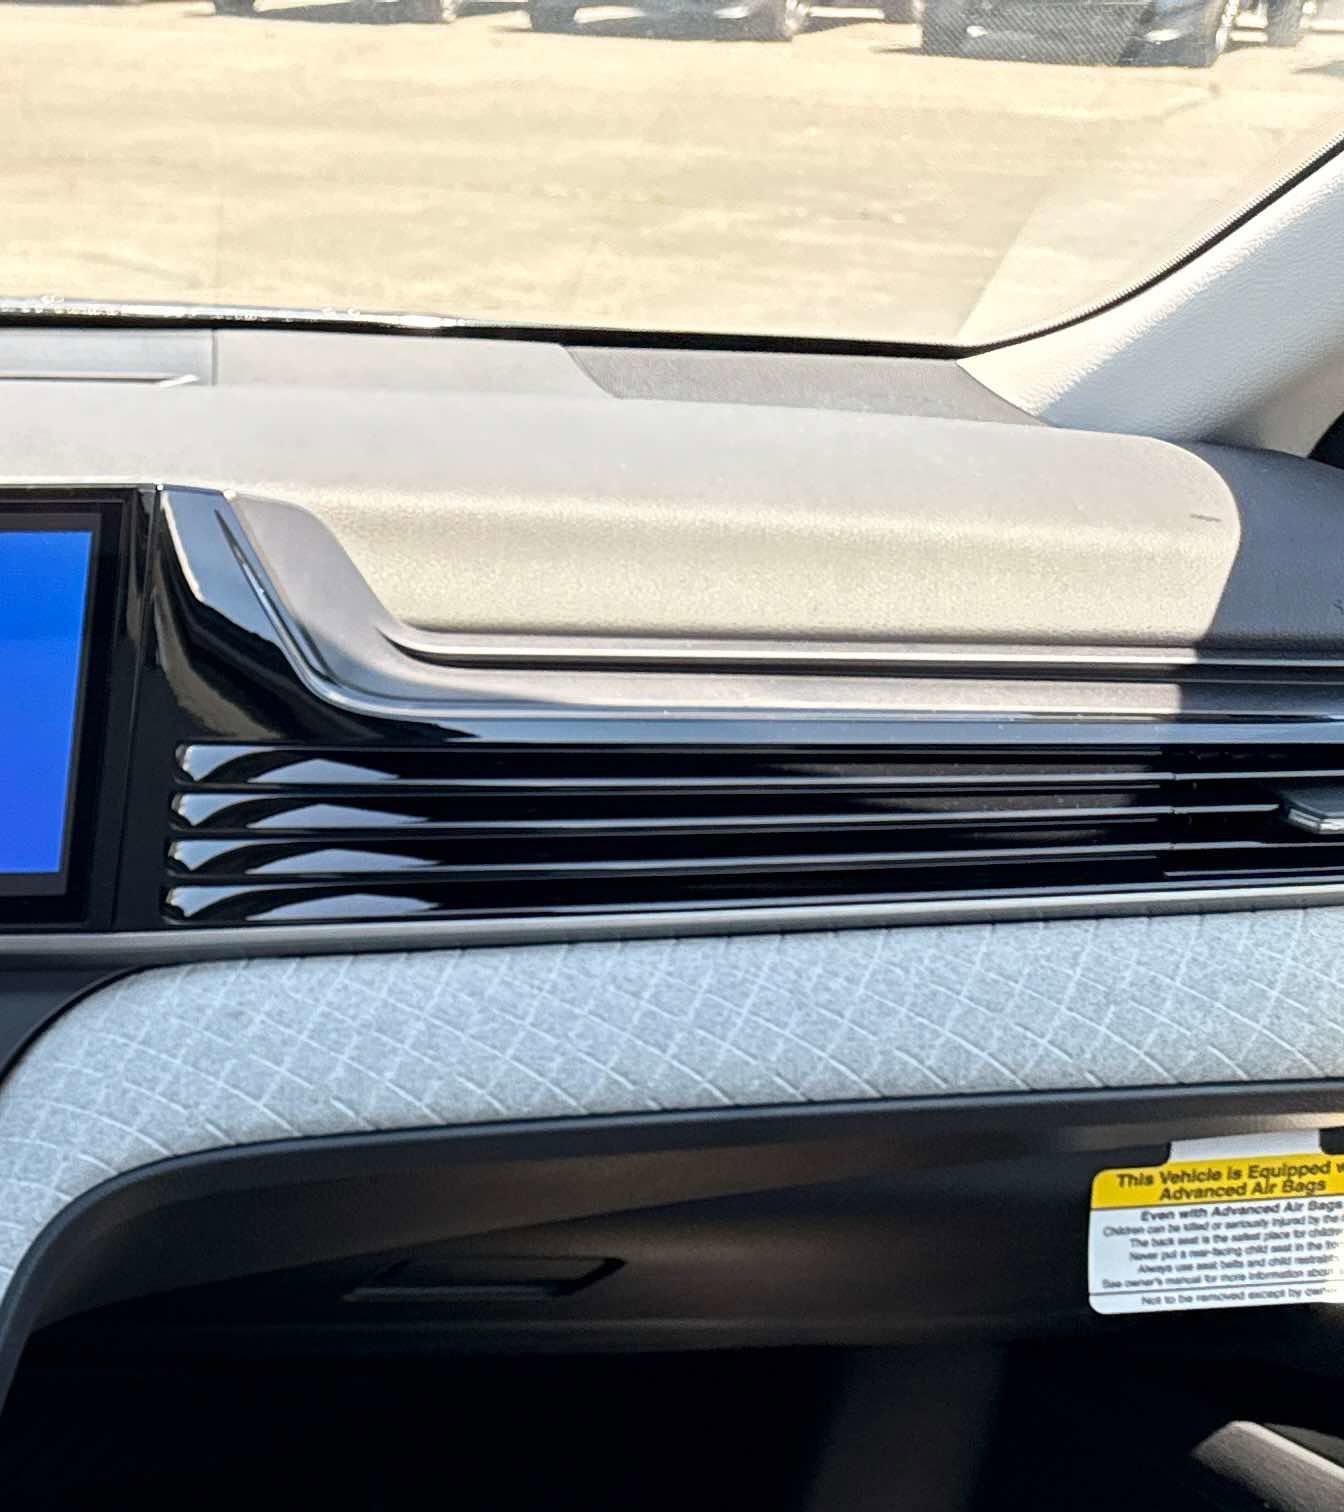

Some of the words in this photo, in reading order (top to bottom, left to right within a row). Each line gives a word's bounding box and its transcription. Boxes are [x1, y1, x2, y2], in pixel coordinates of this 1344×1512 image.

[1117, 1173, 1154, 1188] This
[1159, 1167, 1221, 1184] Vehicle
[1247, 1160, 1331, 1182] Equipped
[1160, 1182, 1247, 1201] Advanced
[1251, 1181, 1277, 1195] Air
[1282, 1179, 1326, 1196] Bags
[1140, 1210, 1175, 1222] Even
[1178, 1207, 1208, 1219] with
[1212, 1203, 1280, 1217] Advanced
[1284, 1201, 1305, 1212] Air
[1307, 1200, 1343, 1213] Bags
